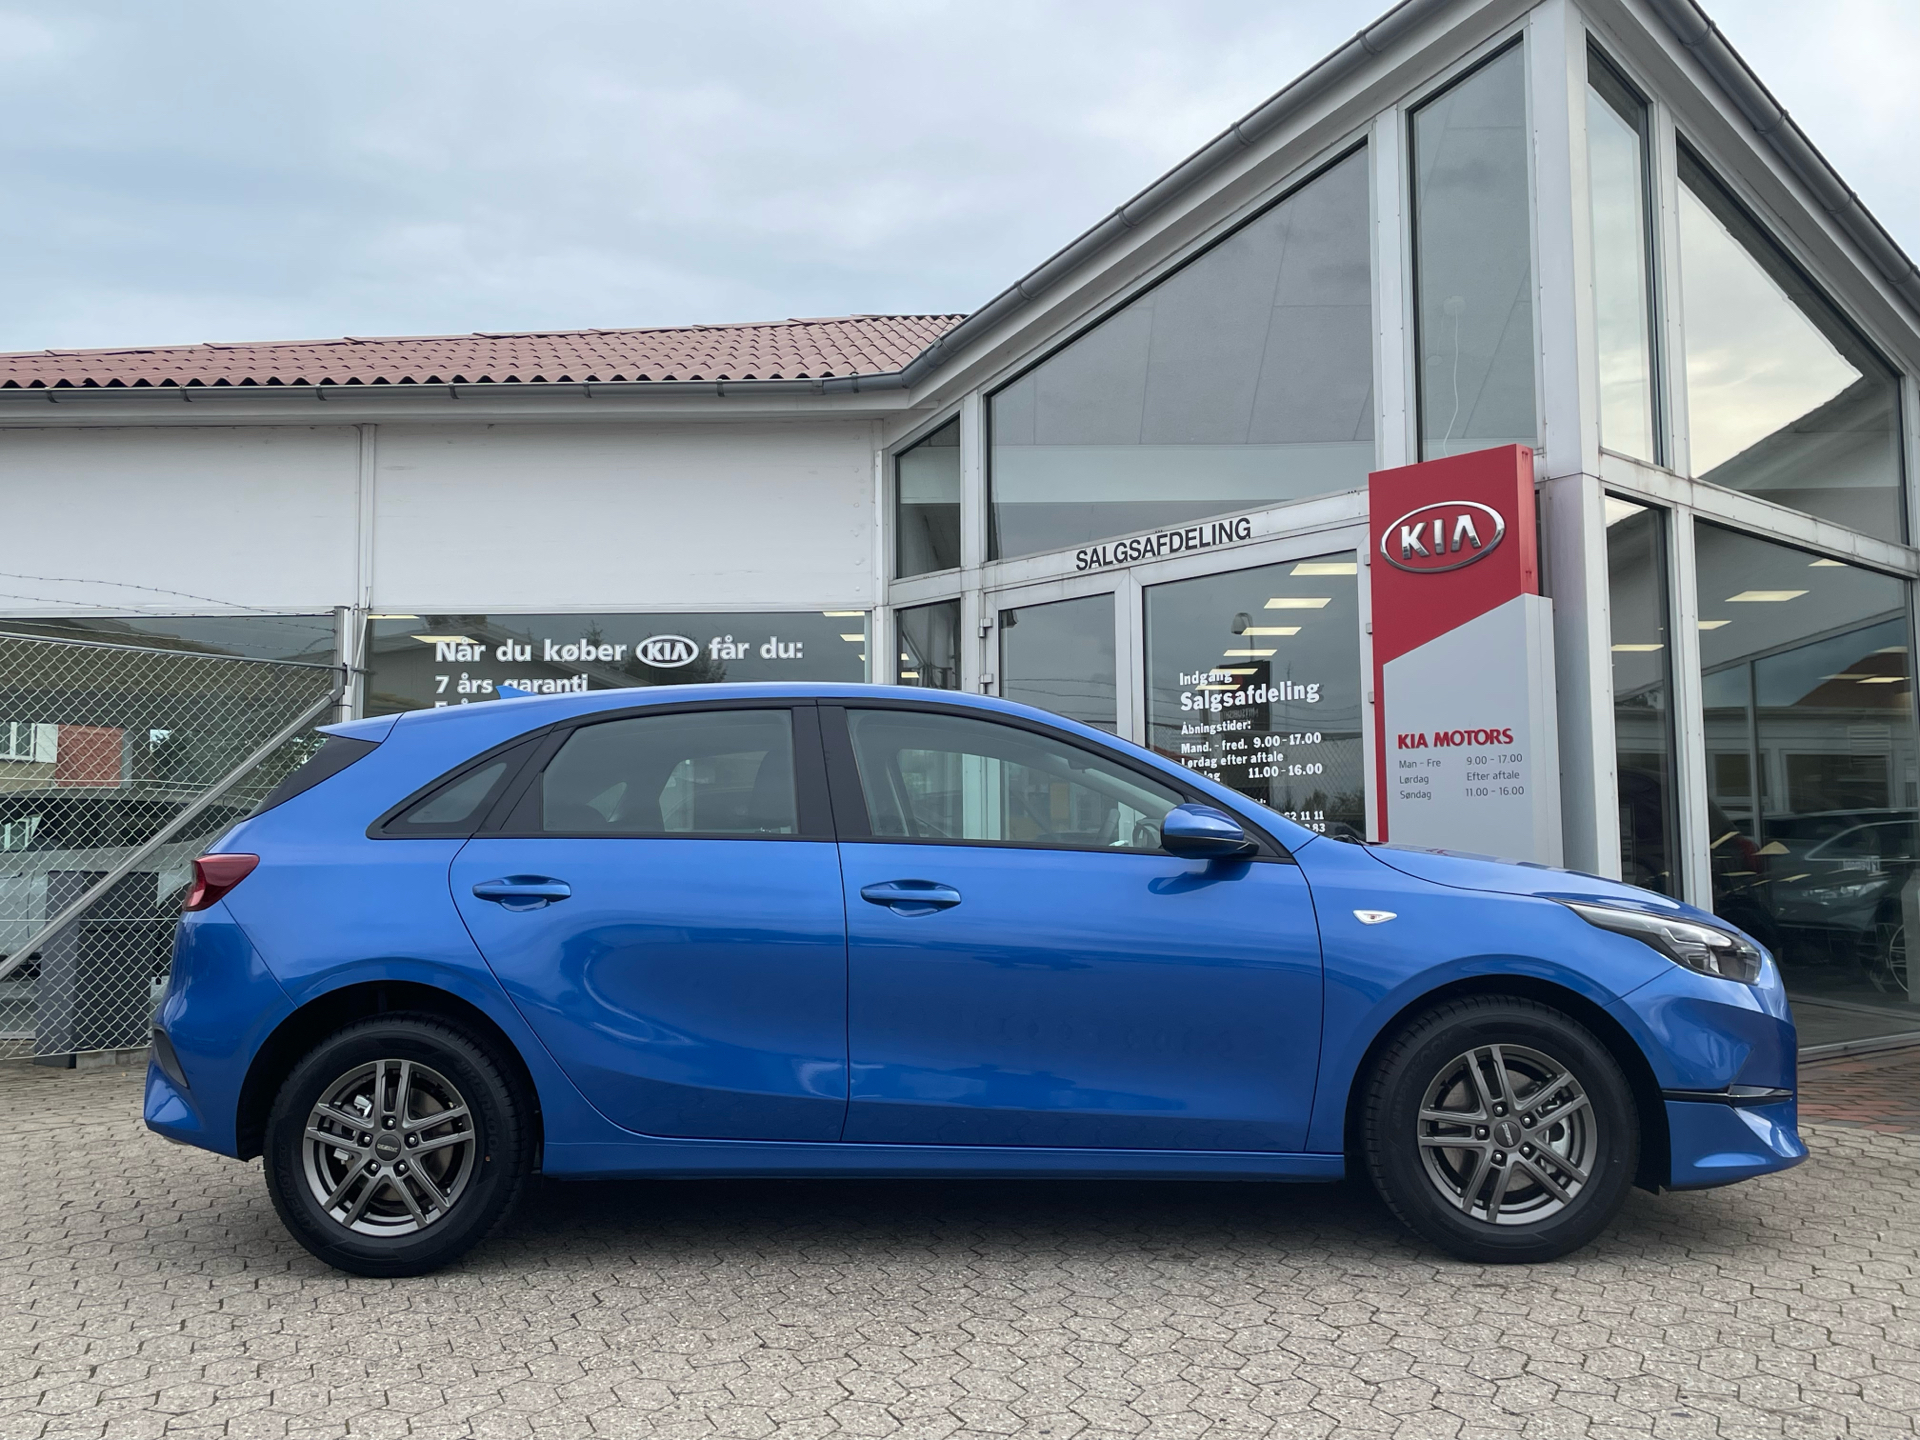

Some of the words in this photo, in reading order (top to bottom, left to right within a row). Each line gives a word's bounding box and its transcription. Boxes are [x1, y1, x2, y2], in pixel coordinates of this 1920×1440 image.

[1075, 517, 1251, 572] SALGSAFDELING
[1400, 514, 1482, 560] KIA
[435, 637, 486, 662] Når
[496, 638, 532, 662] du
[543, 638, 628, 663] køber
[646, 641, 690, 661] KIA
[708, 634, 750, 660] får
[760, 636, 804, 660] du:
[435, 675, 450, 694] 7
[457, 672, 494, 694] års
[1179, 670, 1233, 686] Indgang
[1180, 680, 1320, 712] Salgsafdeling
[1181, 720, 1251, 735] Åbningstider:
[1181, 742, 1212, 754] Mand.
[1222, 738, 1248, 751] fred.
[1397, 732, 1429, 749] KIA
[1433, 728, 1514, 748] MOTORS
[1220, 754, 1247, 766] efter
[1250, 751, 1284, 764] aftale
[1399, 760, 1417, 769] Man
[1427, 759, 1441, 768] Fre
[1466, 755, 1487, 766] 9.00
[1498, 753, 1522, 764] 17.00
[1399, 775, 1429, 785] Lørdag
[1466, 771, 1490, 781] Efter
[1493, 770, 1520, 780] aftale
[1400, 790, 1432, 801] Søndag
[1465, 787, 1488, 797] 11.00
[1499, 786, 1525, 796] 16.00
